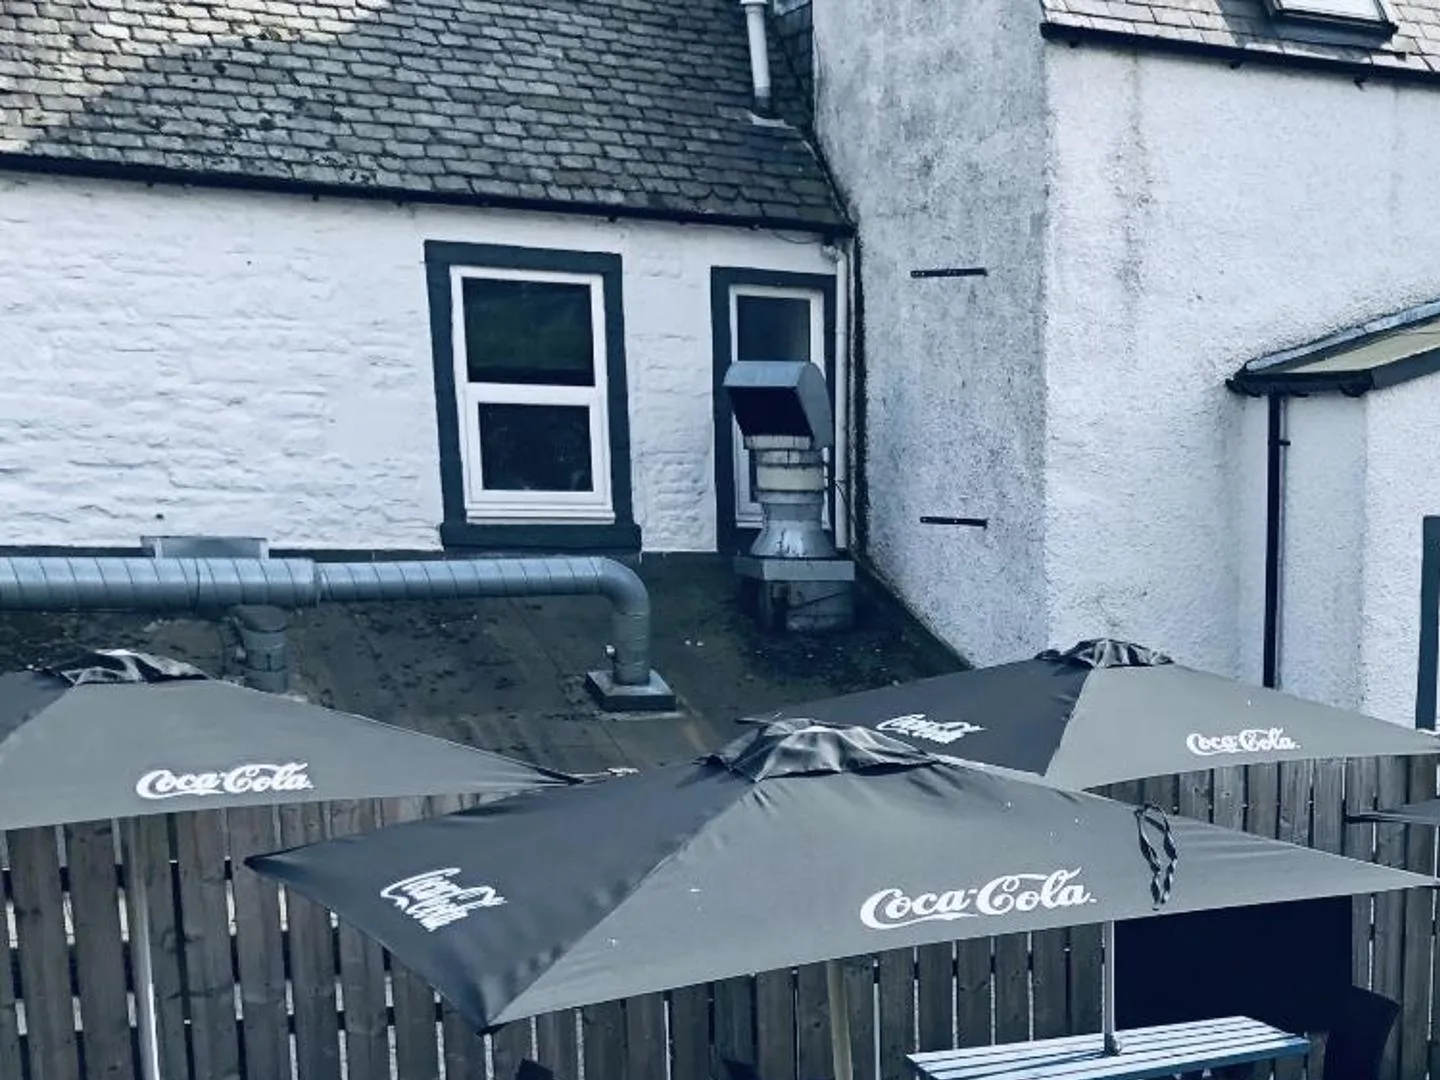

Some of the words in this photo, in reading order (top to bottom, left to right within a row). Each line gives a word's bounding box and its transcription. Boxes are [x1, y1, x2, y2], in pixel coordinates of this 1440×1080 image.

[1186, 728, 1301, 755] Coca-Cola
[136, 762, 315, 799] Coca-Cola
[859, 866, 1097, 930] Coca-Cola
